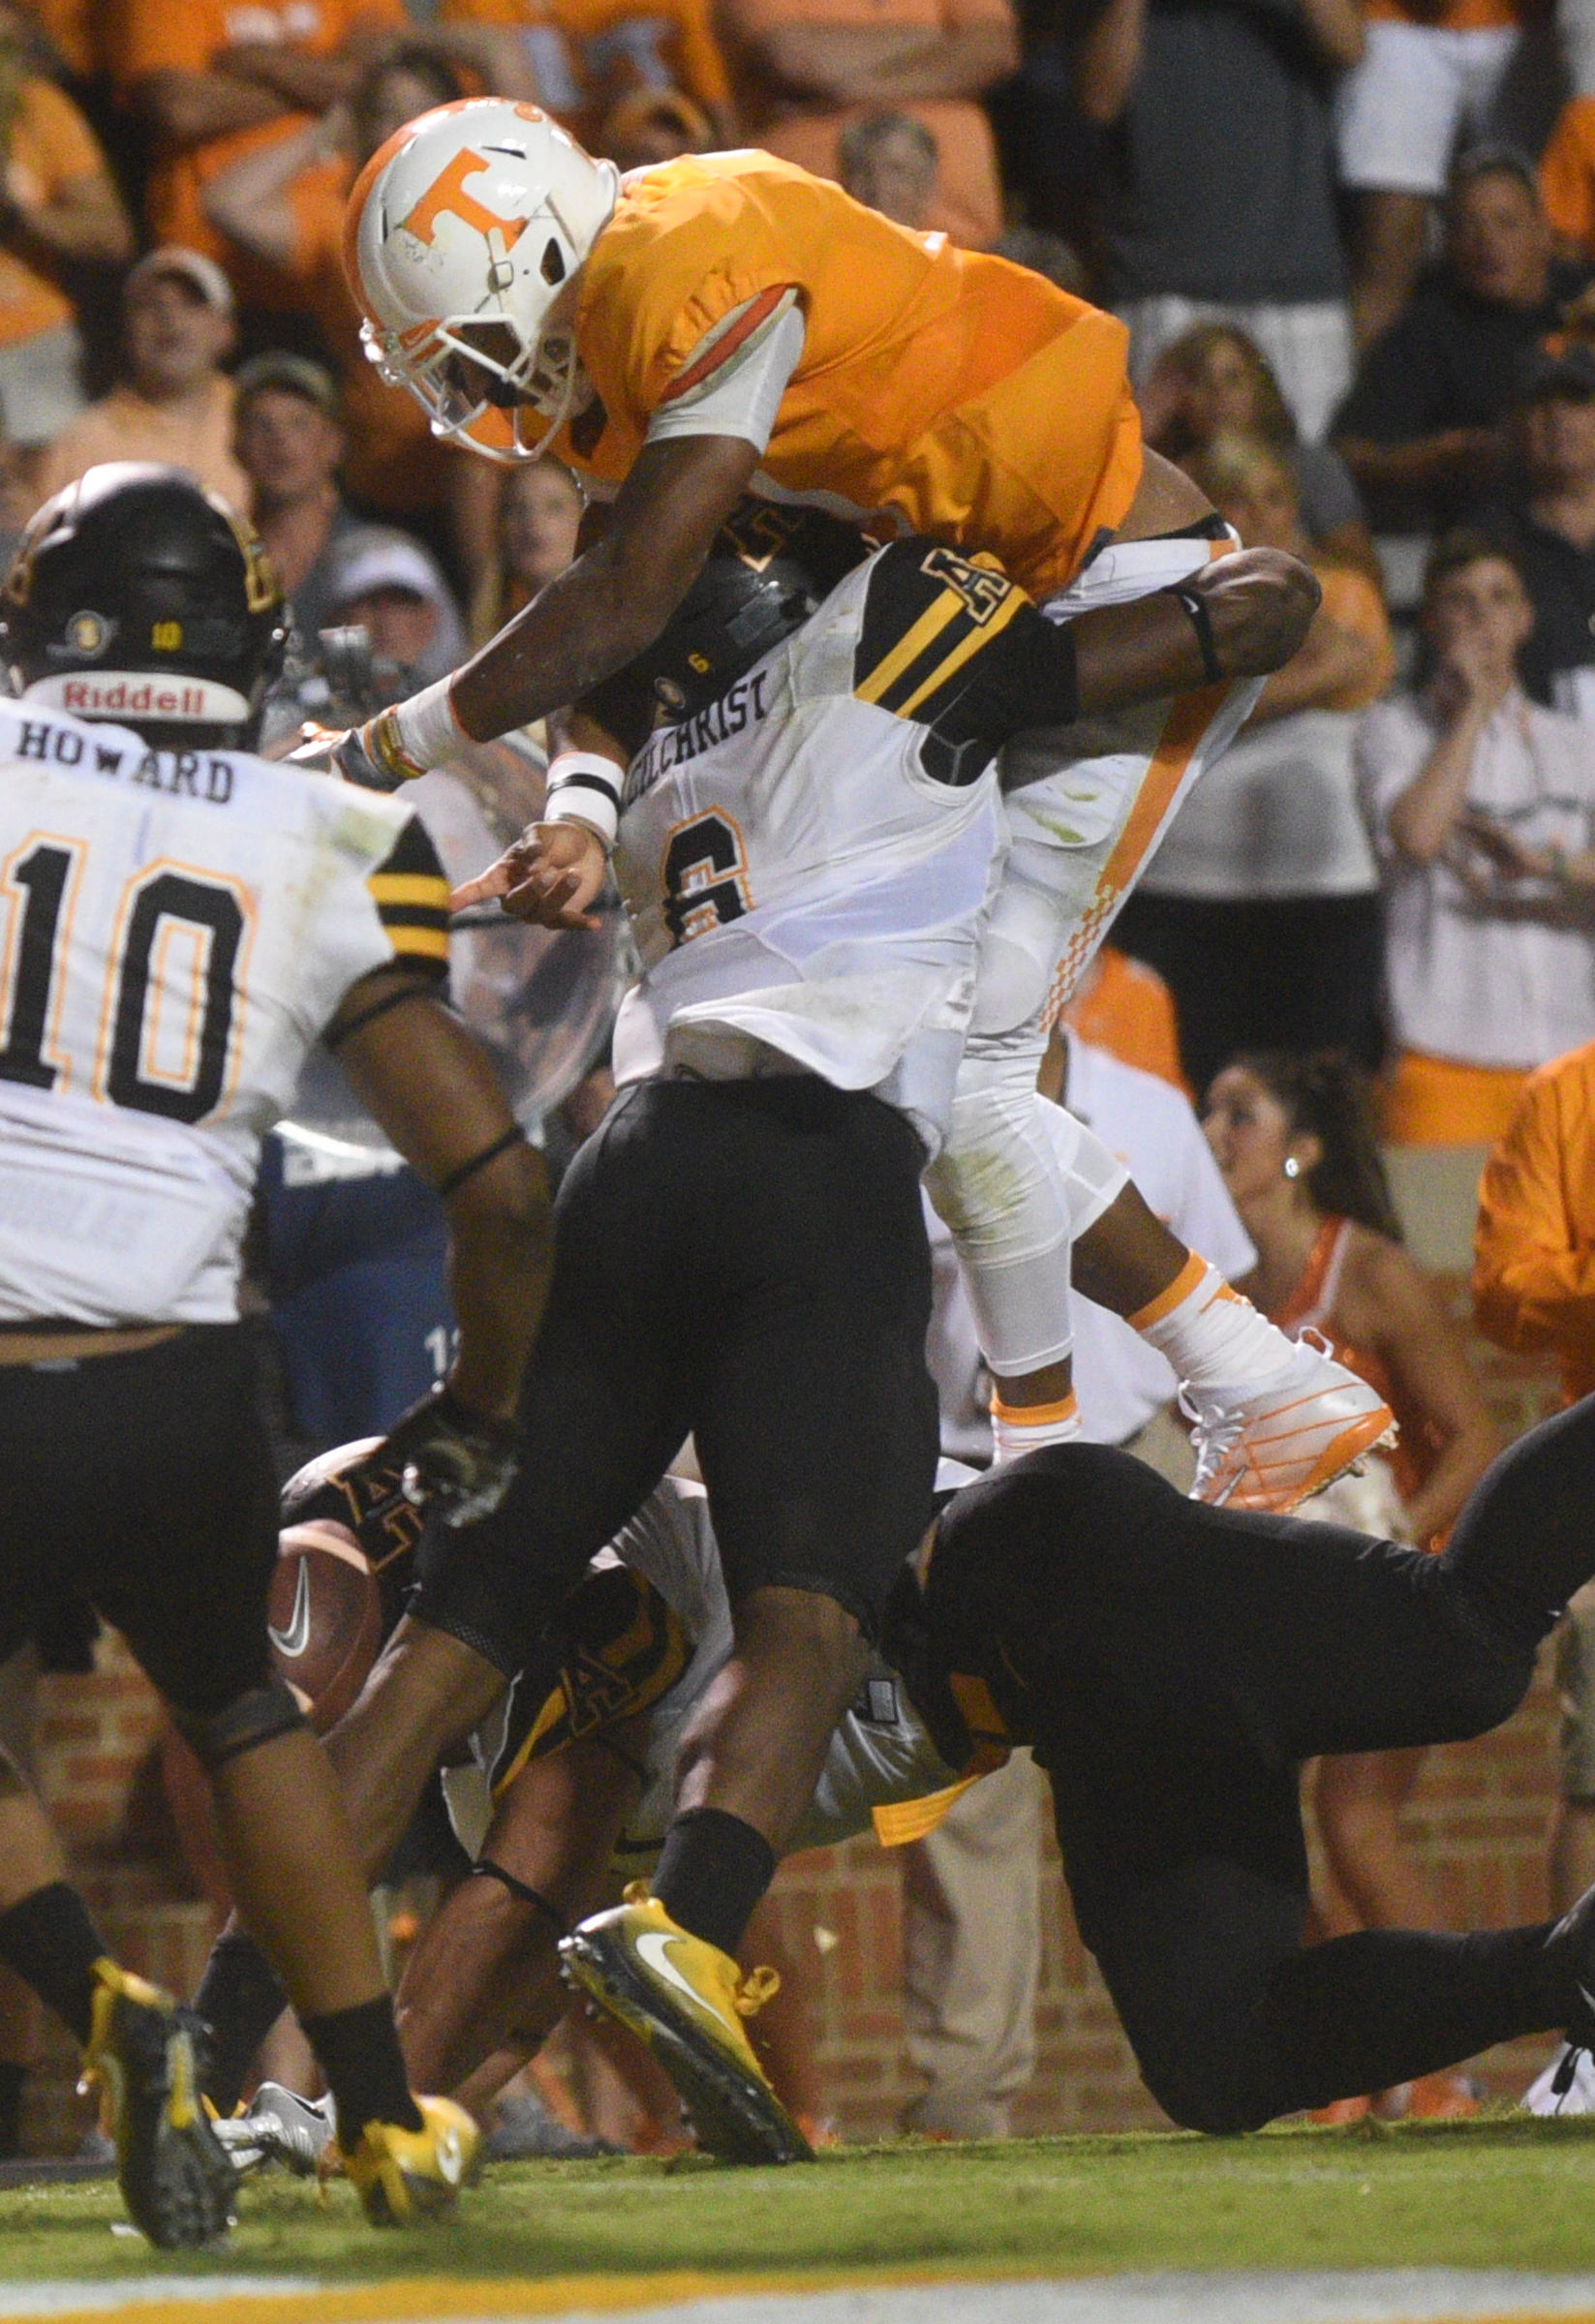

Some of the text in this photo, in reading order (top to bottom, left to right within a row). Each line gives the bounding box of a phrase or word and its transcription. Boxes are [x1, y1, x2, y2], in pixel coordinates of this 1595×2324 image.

[403, 146, 530, 254] T
[920, 547, 1012, 627] A
[151, 621, 184, 652] 10
[688, 651, 710, 674] 6
[63, 681, 205, 715] Riddell
[16, 721, 235, 804] HOWARD
[659, 804, 758, 955] 6
[0, 829, 261, 1131] 10
